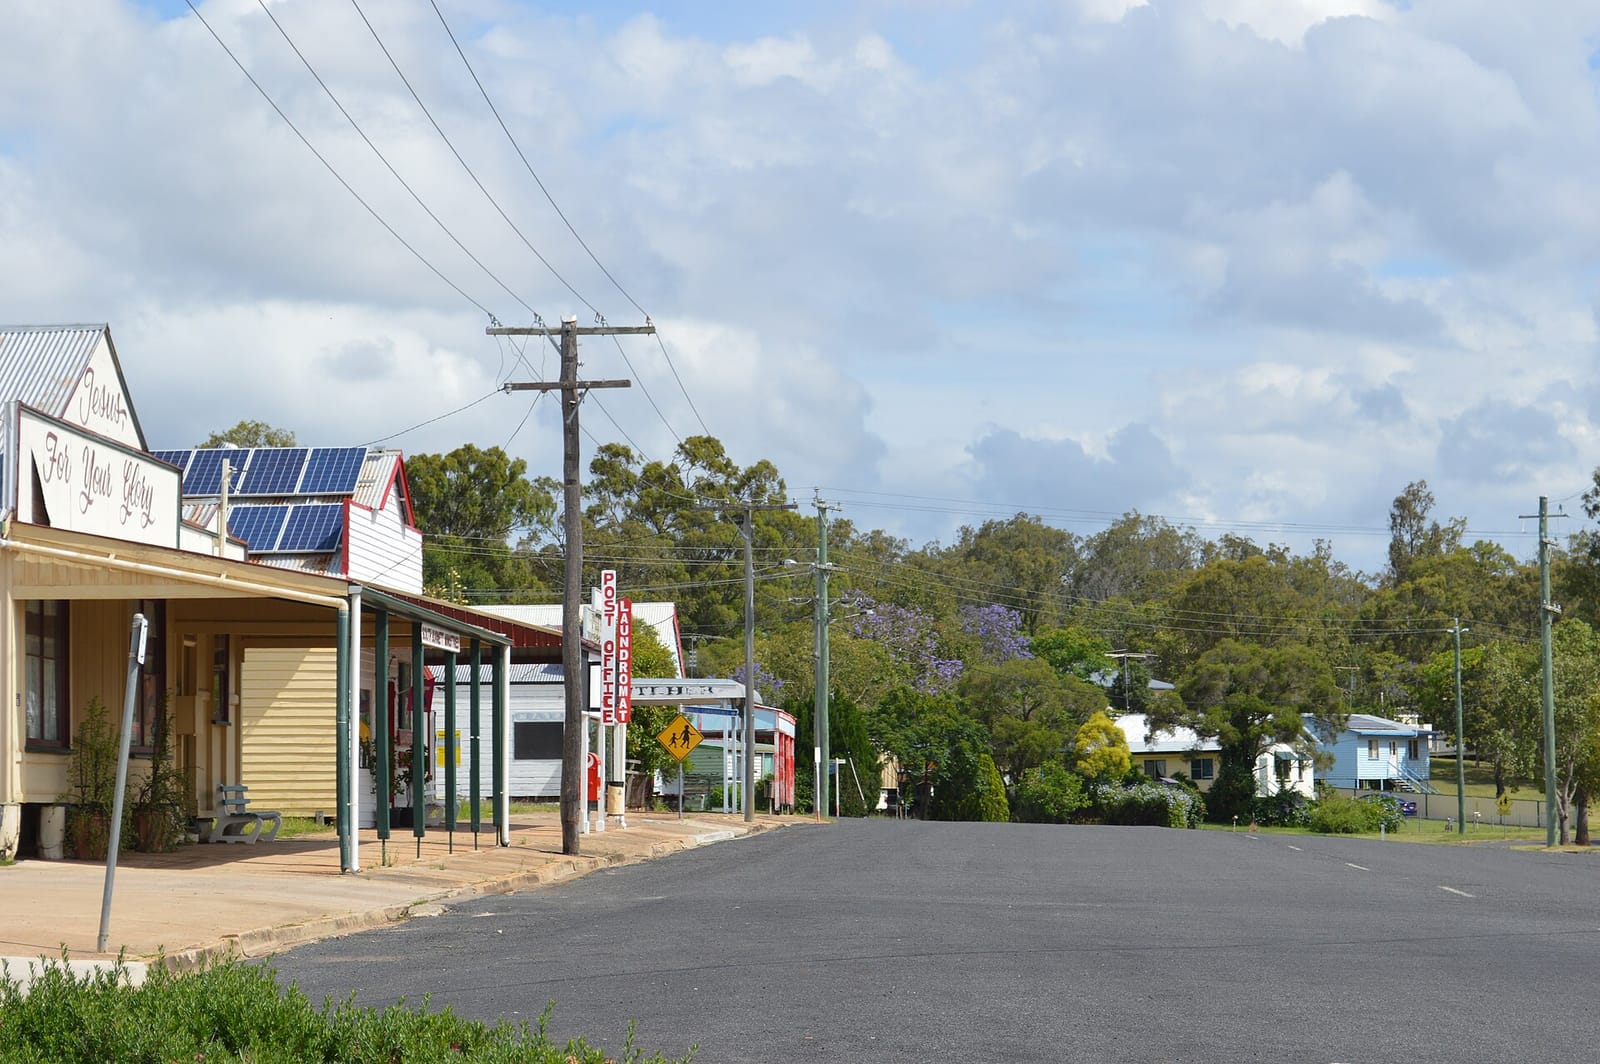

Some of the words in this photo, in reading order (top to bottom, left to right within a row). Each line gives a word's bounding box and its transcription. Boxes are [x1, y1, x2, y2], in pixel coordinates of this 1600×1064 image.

[42, 431, 72, 483] For
[79, 445, 113, 515] Your
[119, 459, 156, 529] Glory
[603, 573, 615, 626] POST
[603, 641, 615, 724] OFFICE
[618, 601, 629, 721] LAUNDROMAT
